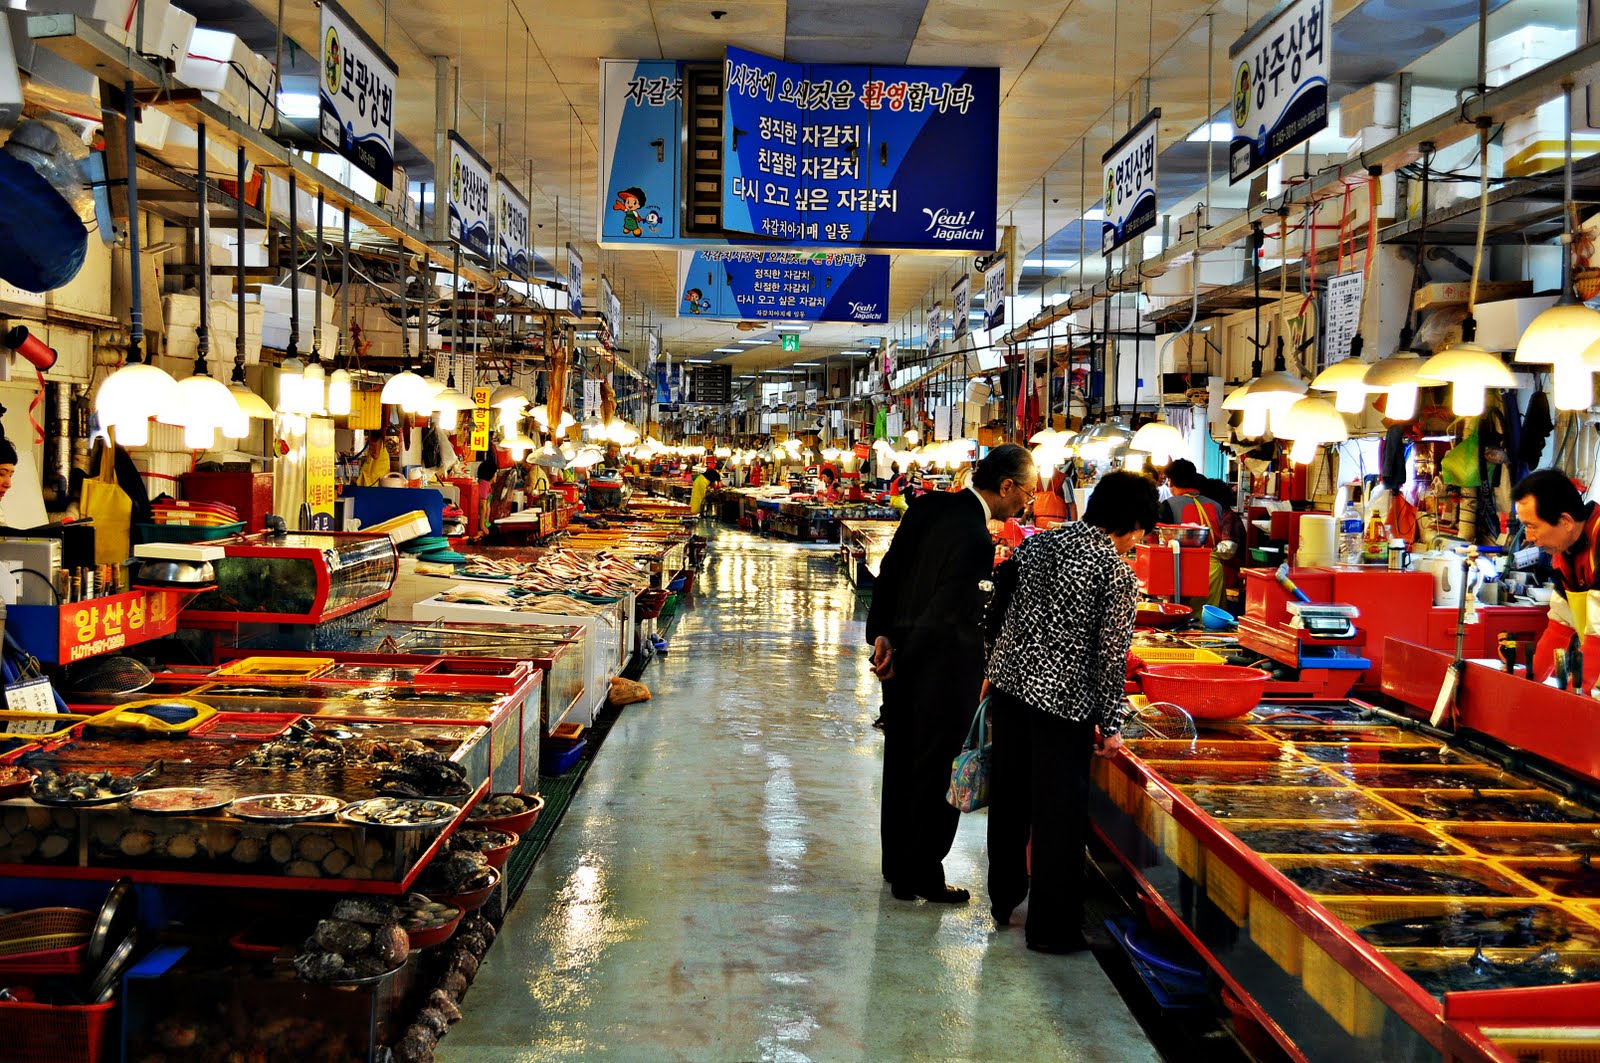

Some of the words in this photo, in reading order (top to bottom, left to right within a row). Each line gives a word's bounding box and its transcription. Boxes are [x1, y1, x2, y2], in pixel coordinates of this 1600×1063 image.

[1252, 0, 1324, 110] 상주상회
[341, 47, 393, 140] 보광상회
[778, 78, 855, 110] 오신것을
[860, 80, 975, 114] 환영합니다
[758, 115, 798, 146] 정직한
[802, 124, 860, 148] 자갈치
[757, 148, 797, 178] 친절한
[801, 156, 859, 180] 자갈치
[1115, 135, 1154, 205] 영진상회
[462, 165, 489, 221] 양산상회
[732, 176, 759, 203] 다시
[763, 182, 790, 207] 오고
[794, 187, 829, 212] 싶은
[836, 188, 898, 213] 자갈치
[761, 217, 819, 240] 자갈치아지매
[824, 222, 852, 240] 일동
[922, 207, 975, 232] Yeah!
[932, 227, 985, 242] Jagalchi
[754, 268, 781, 280] 정직한
[783, 270, 810, 281] 자갈치
[754, 281, 781, 293] 친절한
[783, 283, 810, 294] 자갈치
[737, 294, 755, 305] 다시
[758, 295, 776, 305] 오고
[779, 295, 796, 306] 싶은
[799, 296, 826, 307] 자갈치
[75, 591, 167, 642] 양산상회
